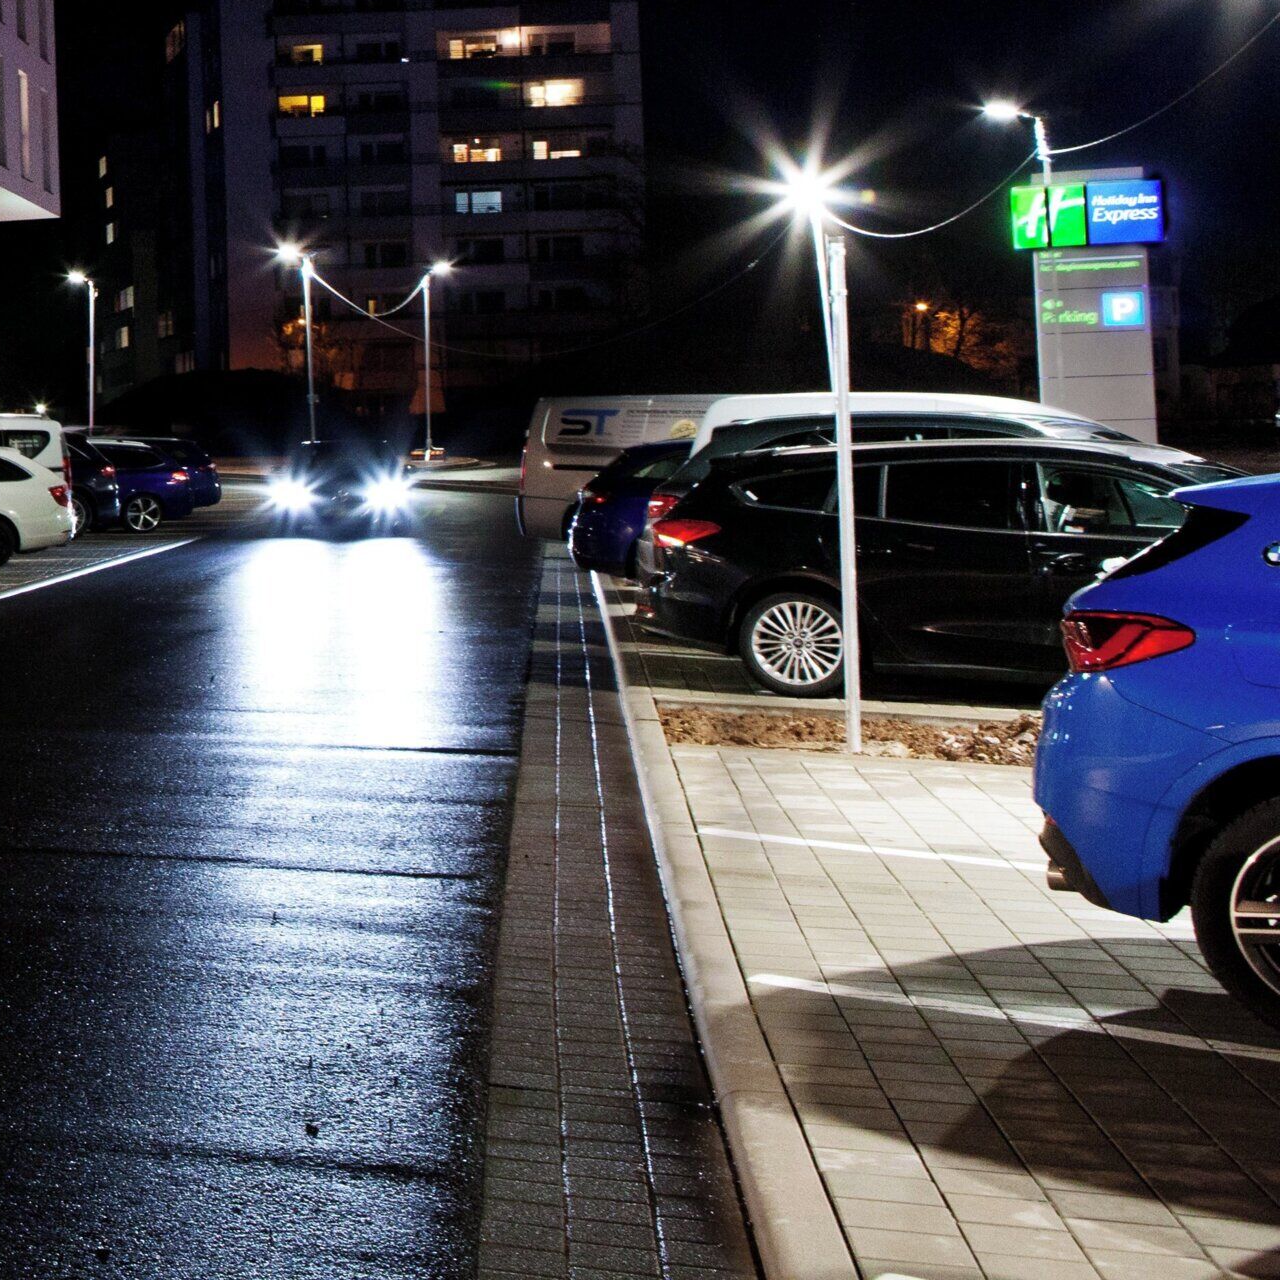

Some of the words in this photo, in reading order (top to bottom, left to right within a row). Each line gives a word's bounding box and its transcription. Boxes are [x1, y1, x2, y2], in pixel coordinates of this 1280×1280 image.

[1091, 194, 1138, 207] Holiday
[1138, 192, 1158, 204] Inn
[1092, 207, 1159, 225] Express
[1111, 297, 1136, 322] P
